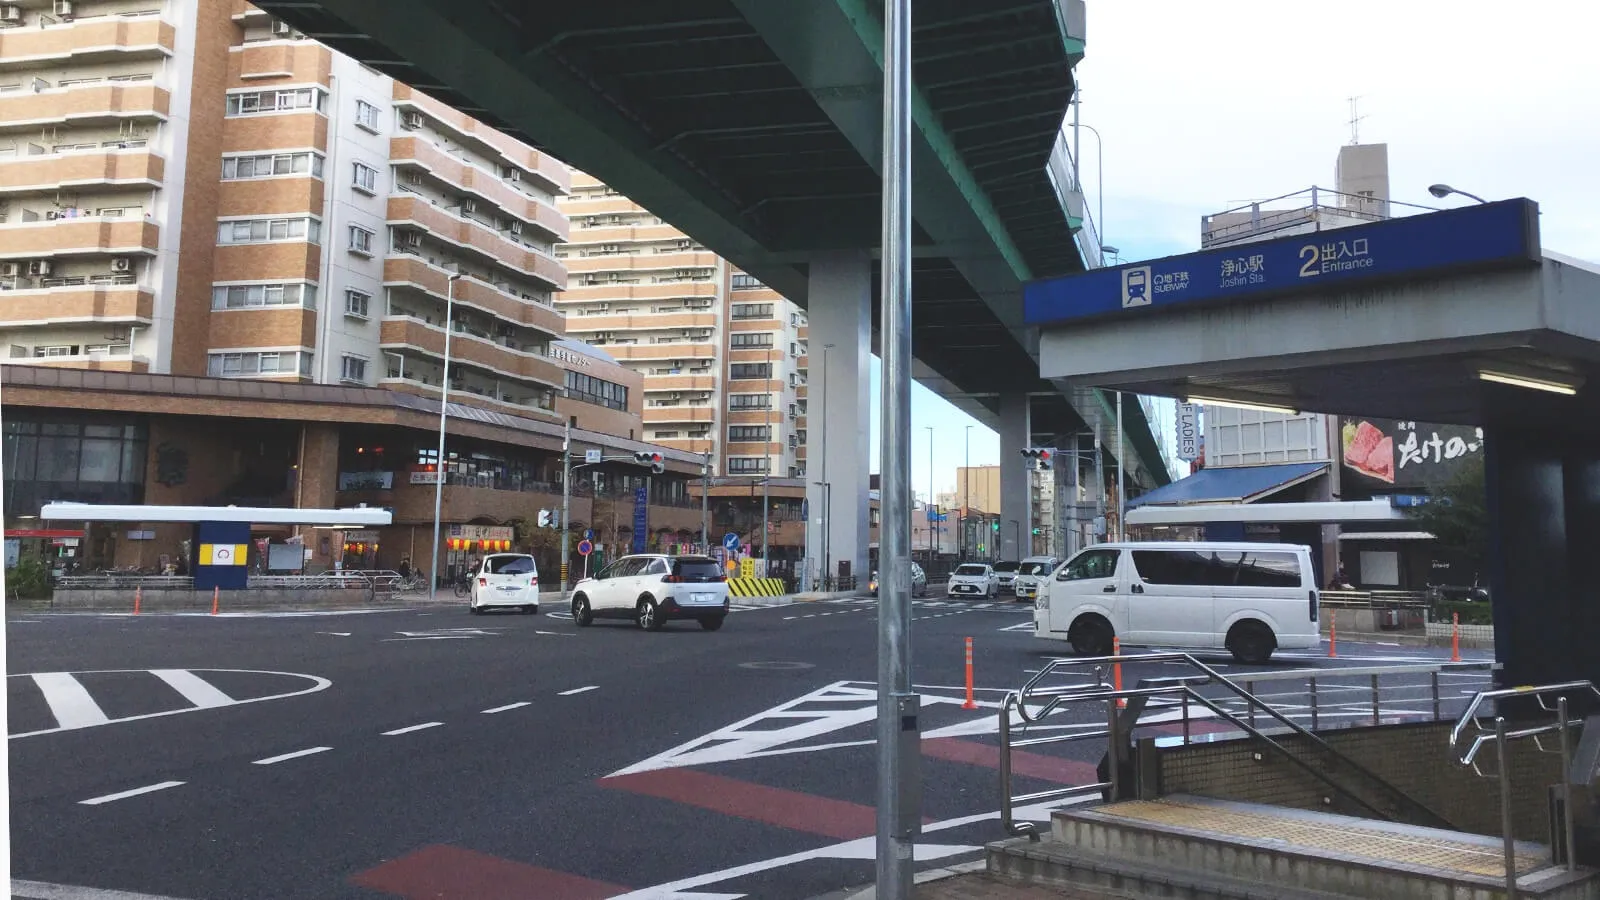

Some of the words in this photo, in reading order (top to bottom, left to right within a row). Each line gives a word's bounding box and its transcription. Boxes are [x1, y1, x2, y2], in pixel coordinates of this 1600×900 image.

[1221, 255, 1264, 277] 浄心駅
[1299, 245, 1320, 277] 2
[1321, 239, 1368, 261] 出入口
[1321, 257, 1373, 273] Entrance
[1164, 271, 1189, 282] 地下鉄
[1220, 275, 1247, 289] Joshin
[1249, 273, 1266, 285] Sta.
[1154, 281, 1189, 294] SUBWAY
[1182, 414, 1195, 456] LADIES'
